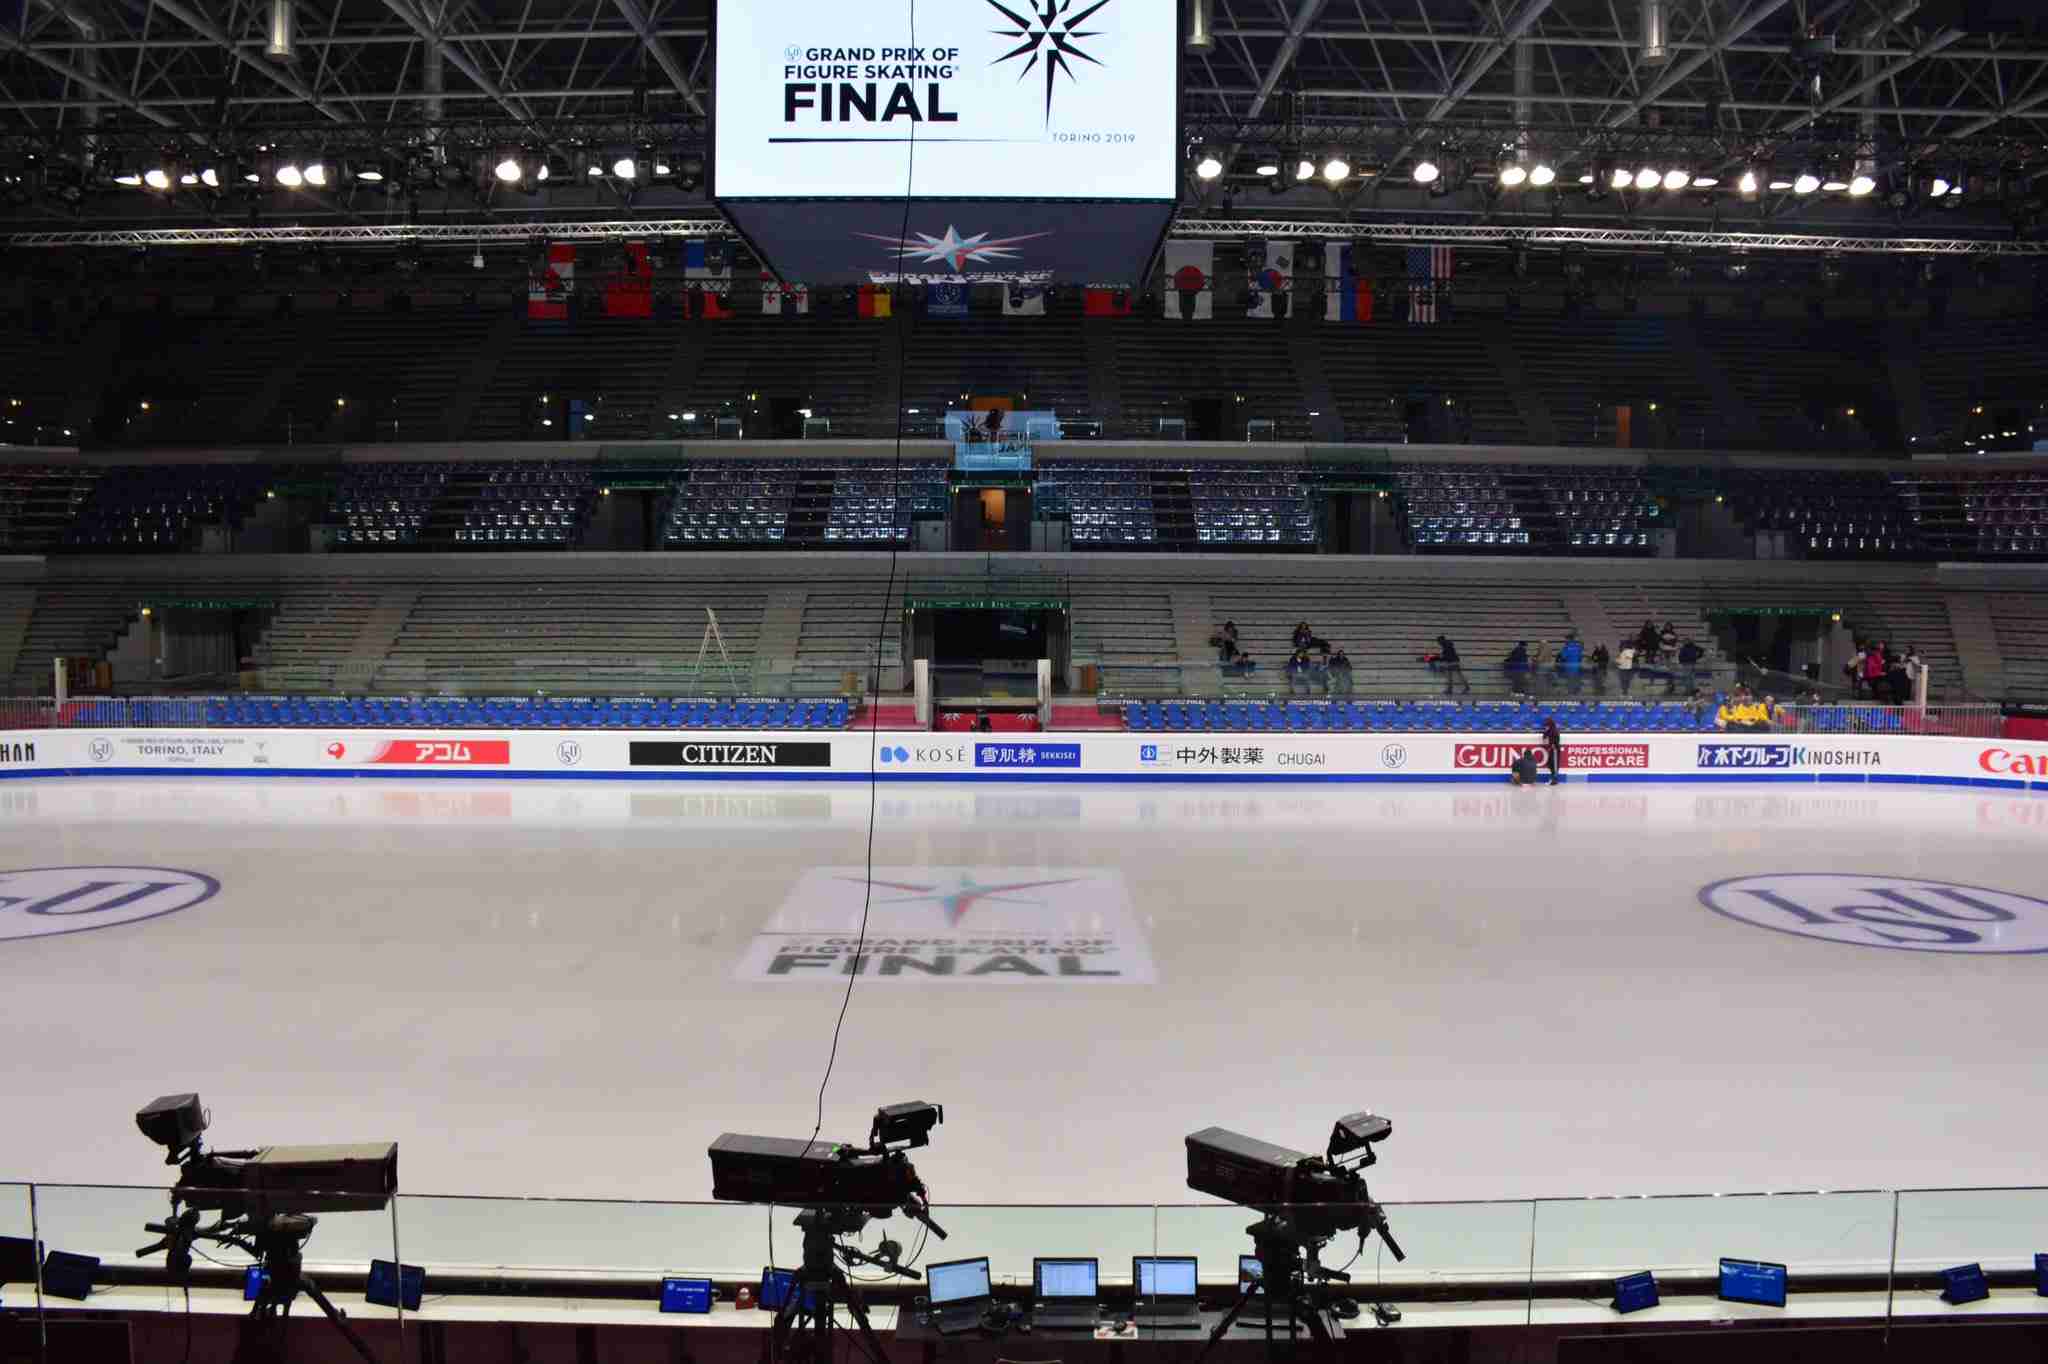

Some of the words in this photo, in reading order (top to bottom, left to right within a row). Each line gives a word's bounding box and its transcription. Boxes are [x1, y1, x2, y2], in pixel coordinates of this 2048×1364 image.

[806, 48, 875, 61] GRAND
[882, 48, 925, 61] PRIX
[932, 48, 959, 61] OF
[785, 65, 858, 79] FIGURE
[865, 65, 953, 79] SKATING
[784, 83, 958, 122] FINAL
[1053, 133, 1101, 143] TORINO
[1106, 133, 1136, 143] 2019
[137, 745, 189, 756] TORINO,
[192, 745, 224, 755] ITALY
[416, 743, 472, 761] アコム
[682, 744, 777, 764] CITIZEN
[916, 746, 967, 762] KOSÉ
[980, 747, 1036, 763] 雪肌精
[1176, 747, 1265, 765] 中外製薬
[1457, 745, 1564, 767] GUINO
[1567, 747, 1644, 755] PROFESSIONAL
[1793, 747, 1881, 766] KINOSHITA
[1277, 753, 1326, 765] CHUGAI
[1567, 756, 1601, 767] SKIN
[1605, 756, 1644, 767] CARE
[767, 955, 1121, 976] FINAL
